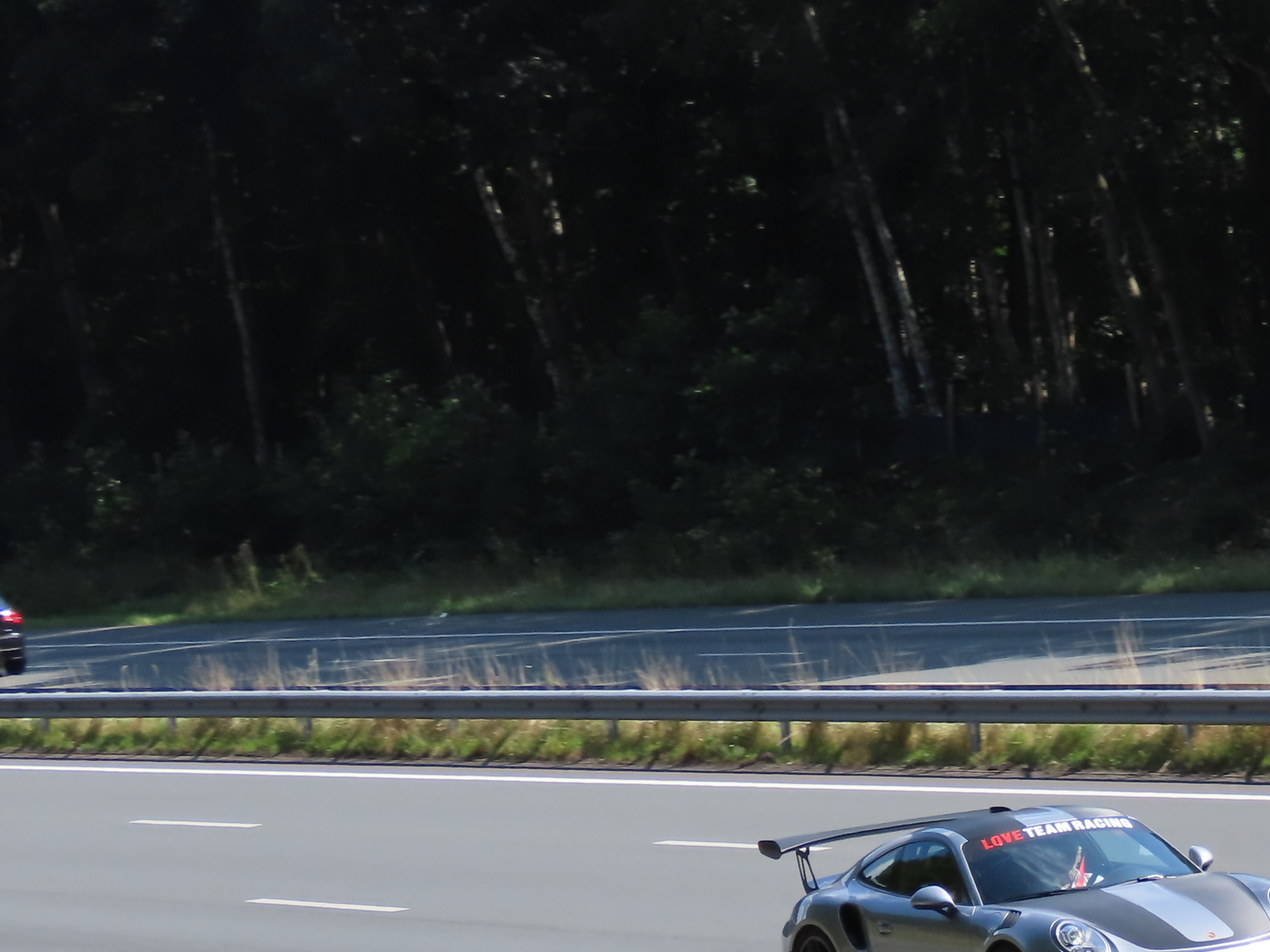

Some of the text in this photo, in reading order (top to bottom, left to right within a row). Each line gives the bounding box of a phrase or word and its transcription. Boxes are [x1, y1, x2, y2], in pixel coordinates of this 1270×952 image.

[981, 817, 1133, 850] LOVE TEAM RACING
